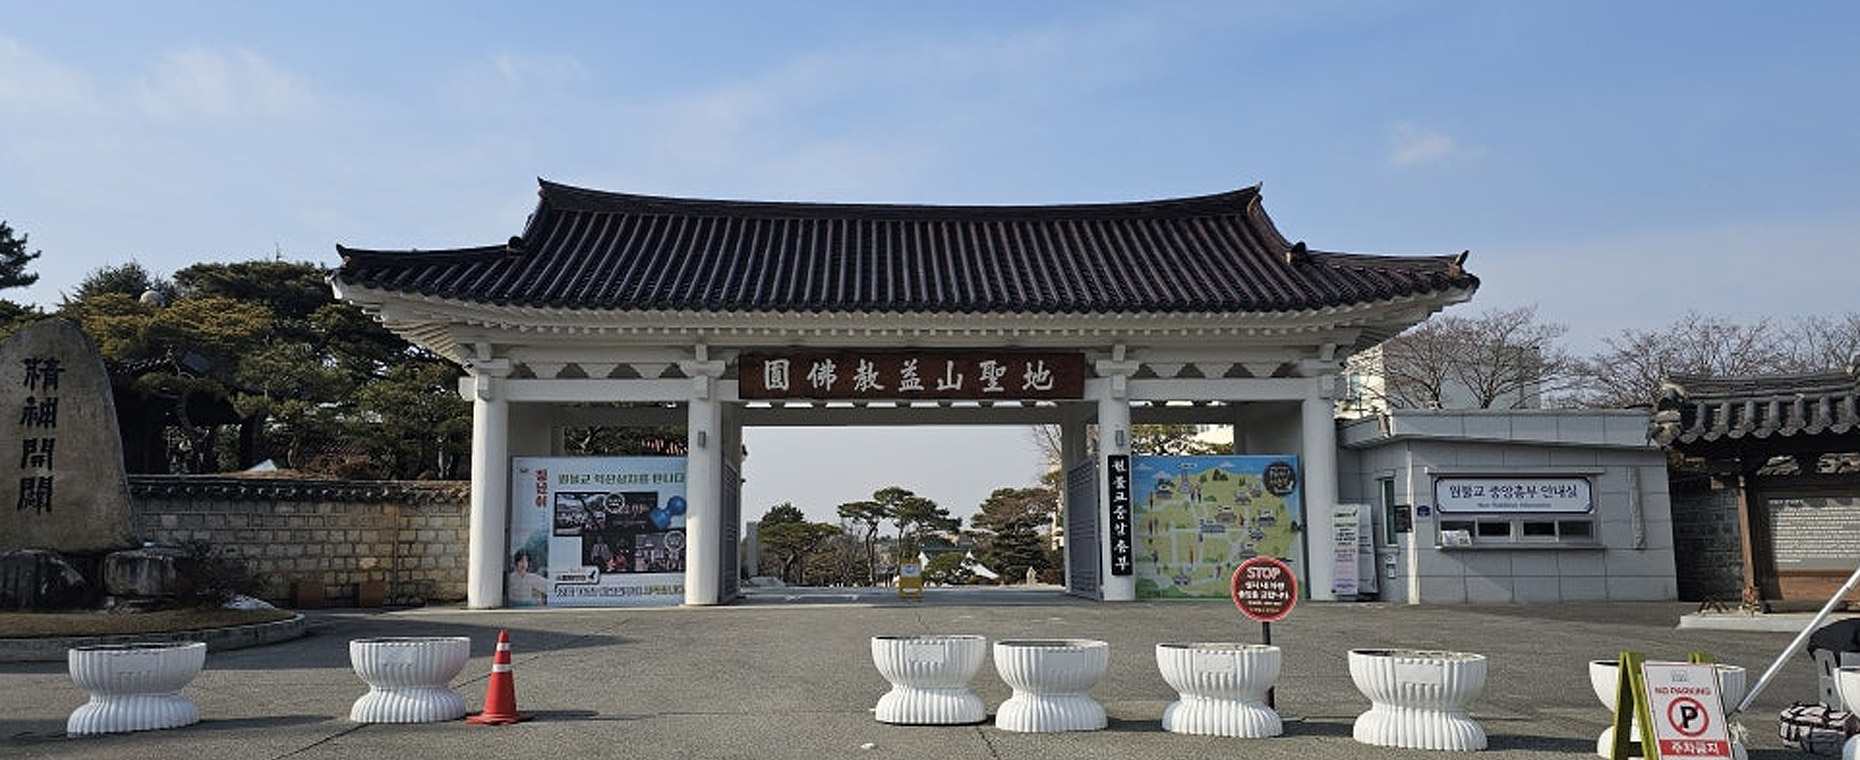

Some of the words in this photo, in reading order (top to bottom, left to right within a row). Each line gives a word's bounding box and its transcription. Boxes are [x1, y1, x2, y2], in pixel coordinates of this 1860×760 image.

[1450, 484, 1485, 499] 원불교
[1540, 484, 1577, 499] 안내실
[1247, 566, 1281, 580] STOP
[1655, 686, 1669, 694] NO
[1670, 687, 1711, 695] PARKING
[1680, 705, 1699, 729] P
